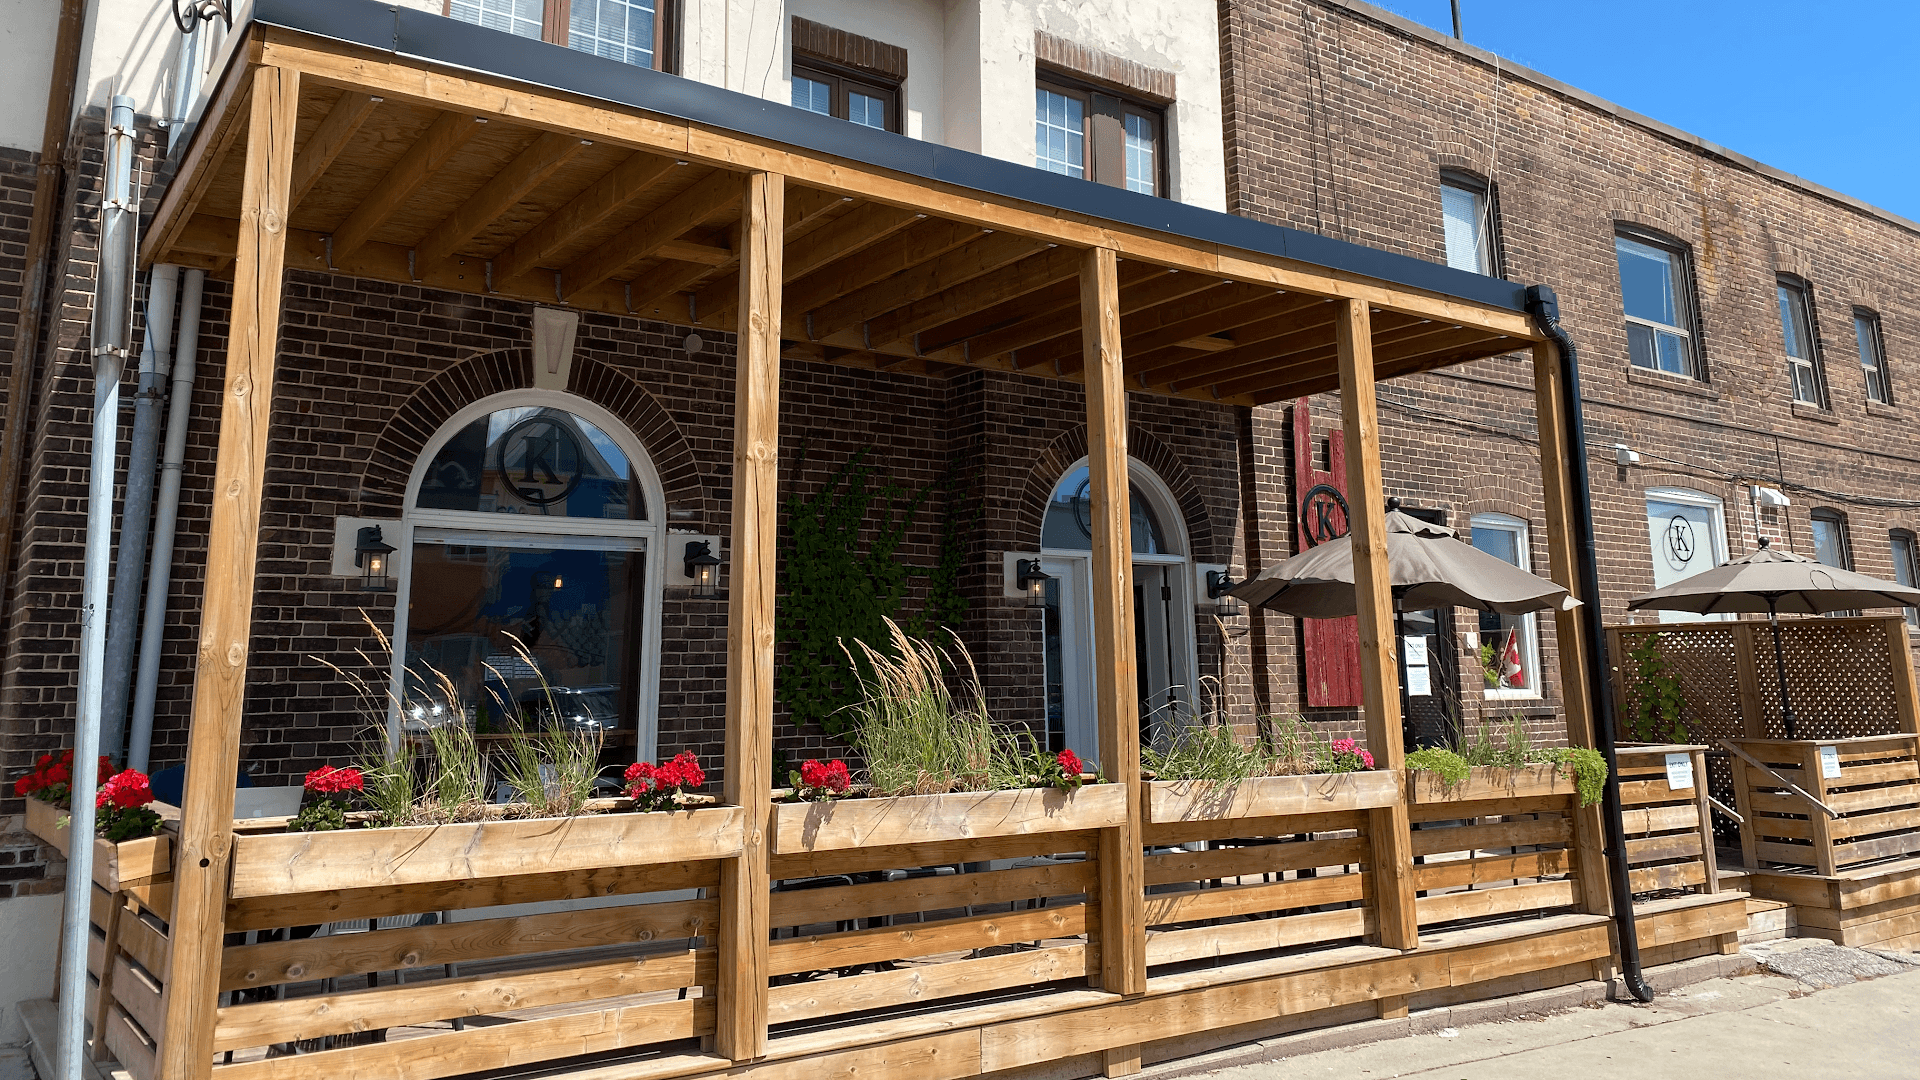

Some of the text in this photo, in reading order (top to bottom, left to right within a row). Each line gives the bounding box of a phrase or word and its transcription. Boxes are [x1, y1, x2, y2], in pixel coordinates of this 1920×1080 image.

[520, 436, 564, 485] K
[1315, 501, 1338, 541] K
[1675, 525, 1690, 551] K
